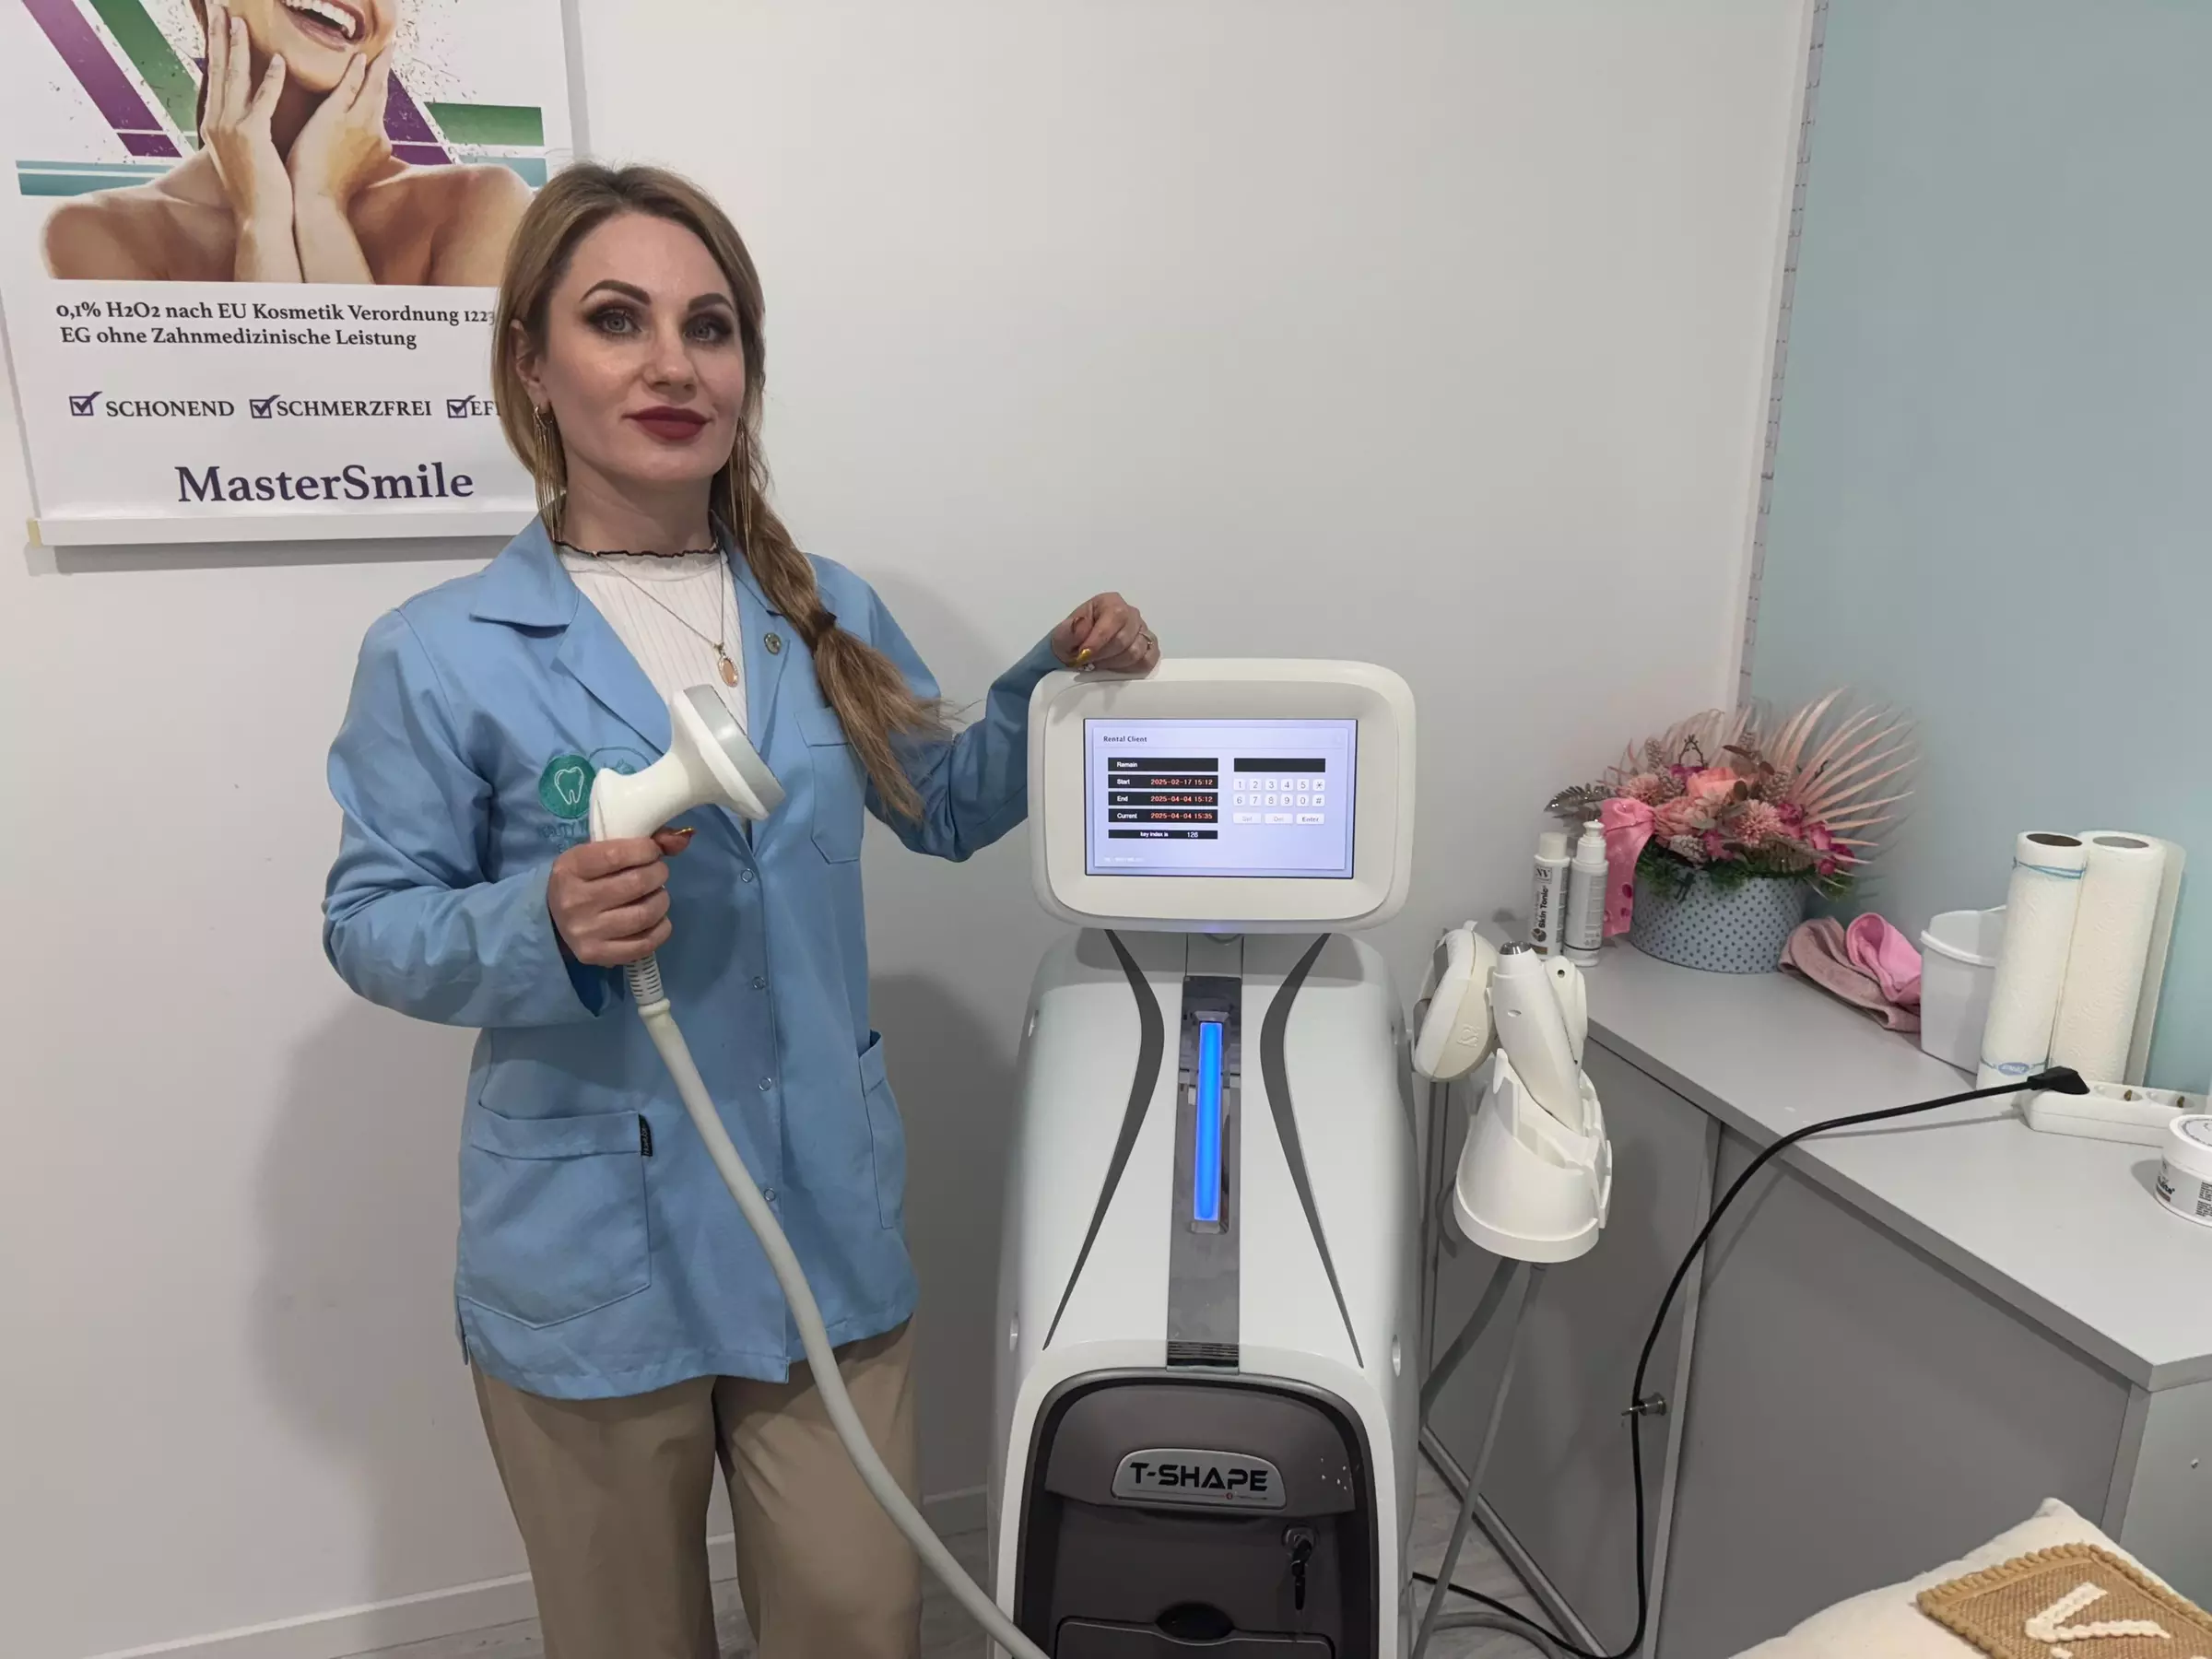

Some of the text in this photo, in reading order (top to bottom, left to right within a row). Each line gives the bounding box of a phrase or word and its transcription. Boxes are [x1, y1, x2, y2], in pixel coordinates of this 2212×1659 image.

[55, 301, 101, 320] 0,1%
[106, 301, 161, 318] H2O2
[166, 301, 214, 319] nach
[218, 302, 246, 319] EU
[253, 304, 345, 320] Kosmetik
[347, 304, 459, 326] Verordnung
[60, 326, 418, 350] EG ohne Zahnmedizinische Leistung
[106, 401, 235, 417] SCHONEND
[276, 400, 432, 417] SCHMERZFREI
[174, 461, 475, 502] MasterSmile
[1537, 911, 1547, 928] Skin
[1129, 1462, 1268, 1491] T-SHAPE
